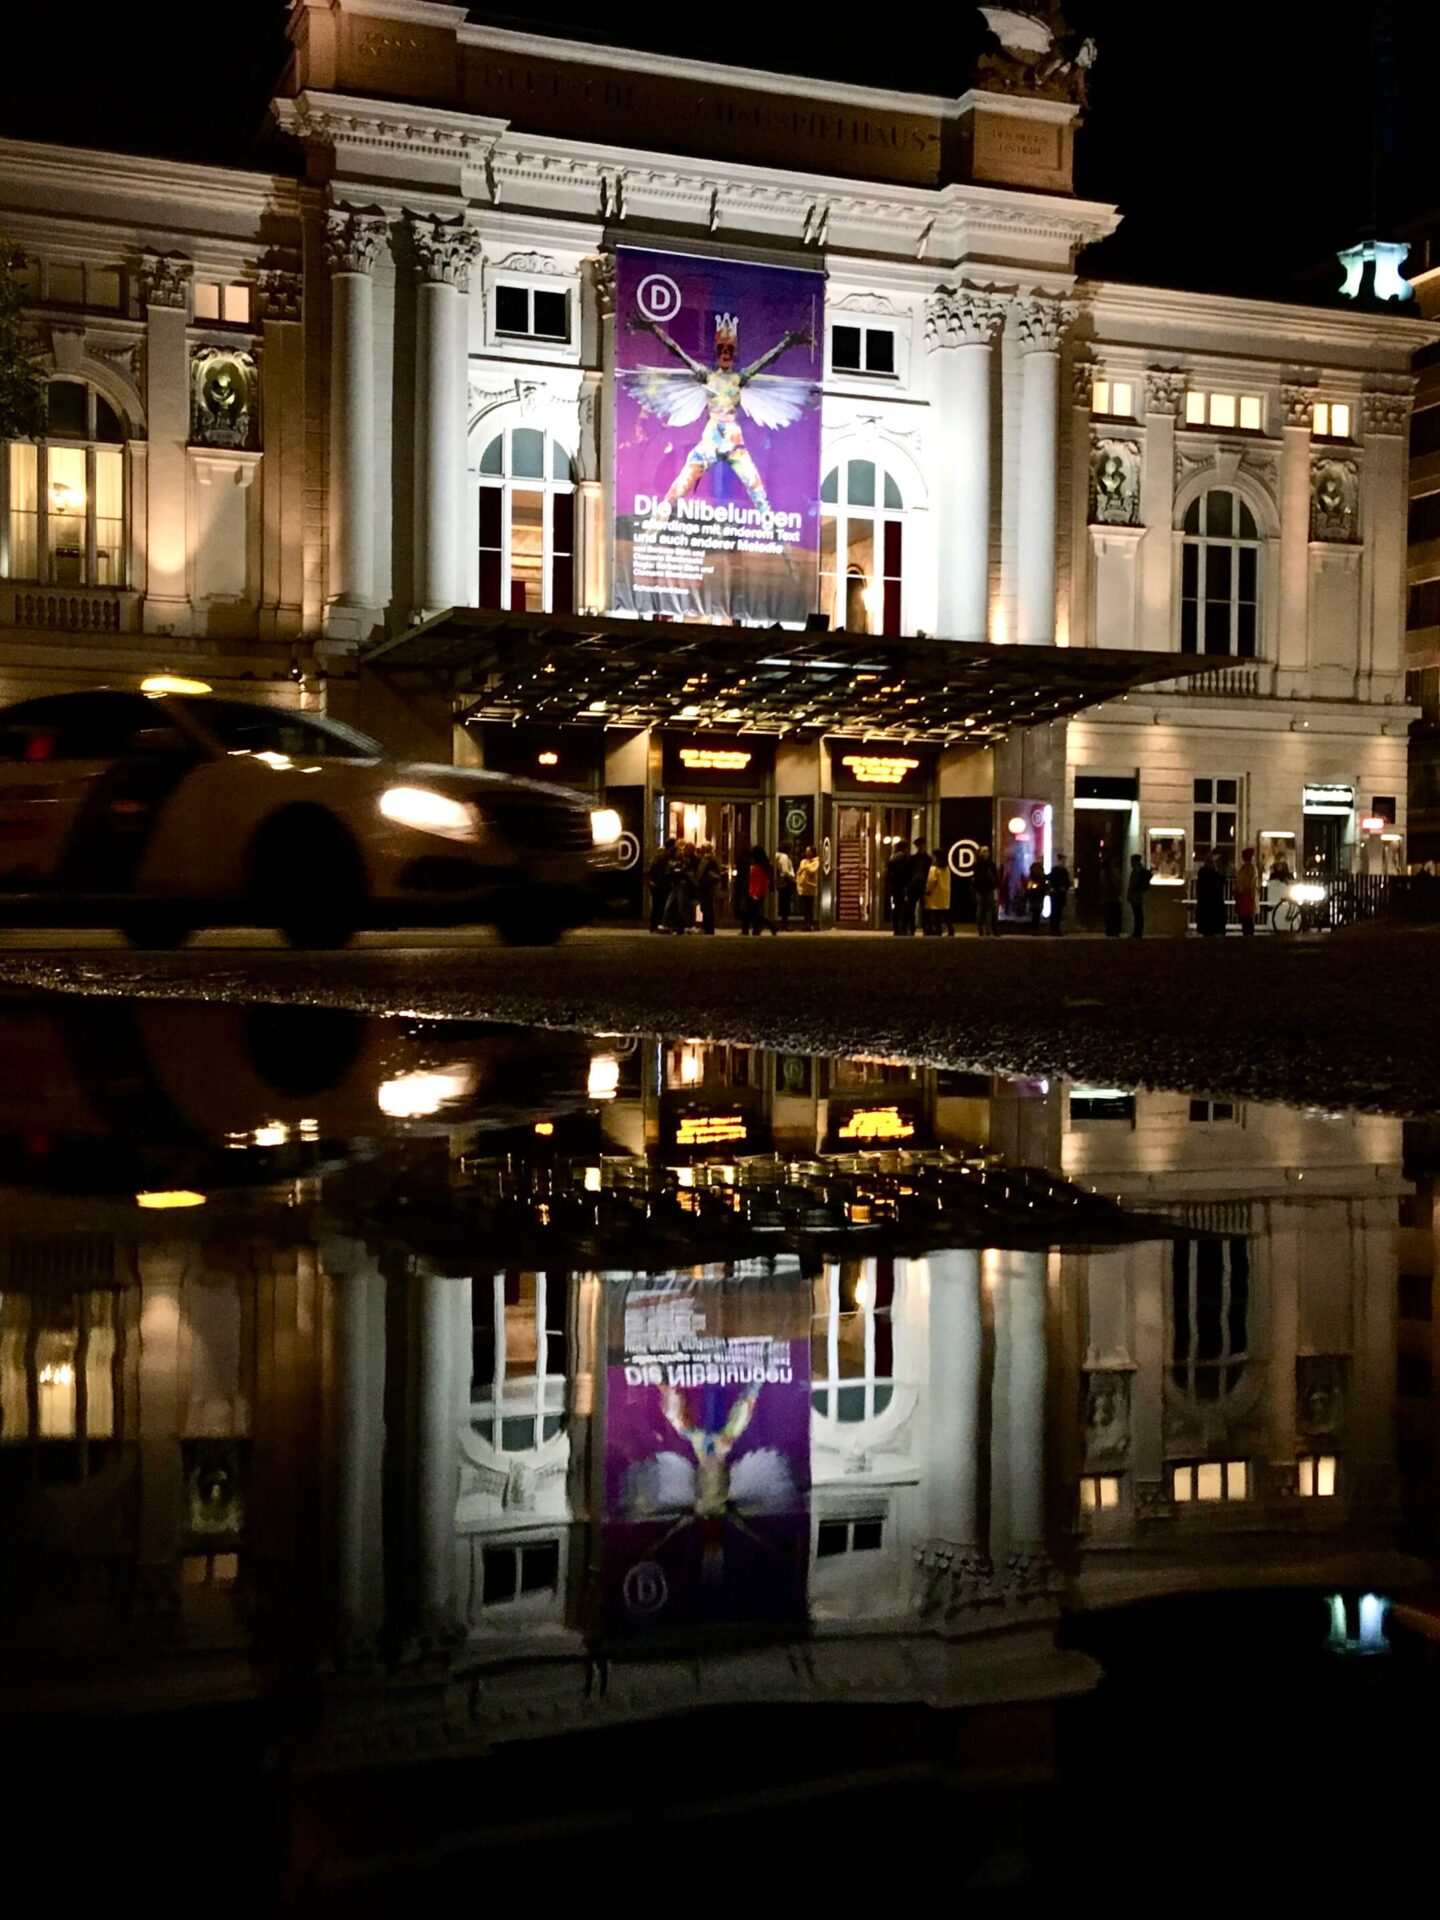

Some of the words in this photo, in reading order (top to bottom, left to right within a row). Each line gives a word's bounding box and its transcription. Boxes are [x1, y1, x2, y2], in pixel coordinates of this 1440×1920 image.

[634, 494, 672, 516] Die
[677, 497, 802, 530] Nibelungen
[633, 532, 656, 544] und
[659, 533, 687, 547] auch
[691, 536, 735, 551] anderer
[737, 539, 784, 554] Melodie
[641, 519, 699, 535] allerdings
[702, 524, 721, 535] mit
[723, 526, 774, 540] anderem
[777, 529, 801, 543] Text
